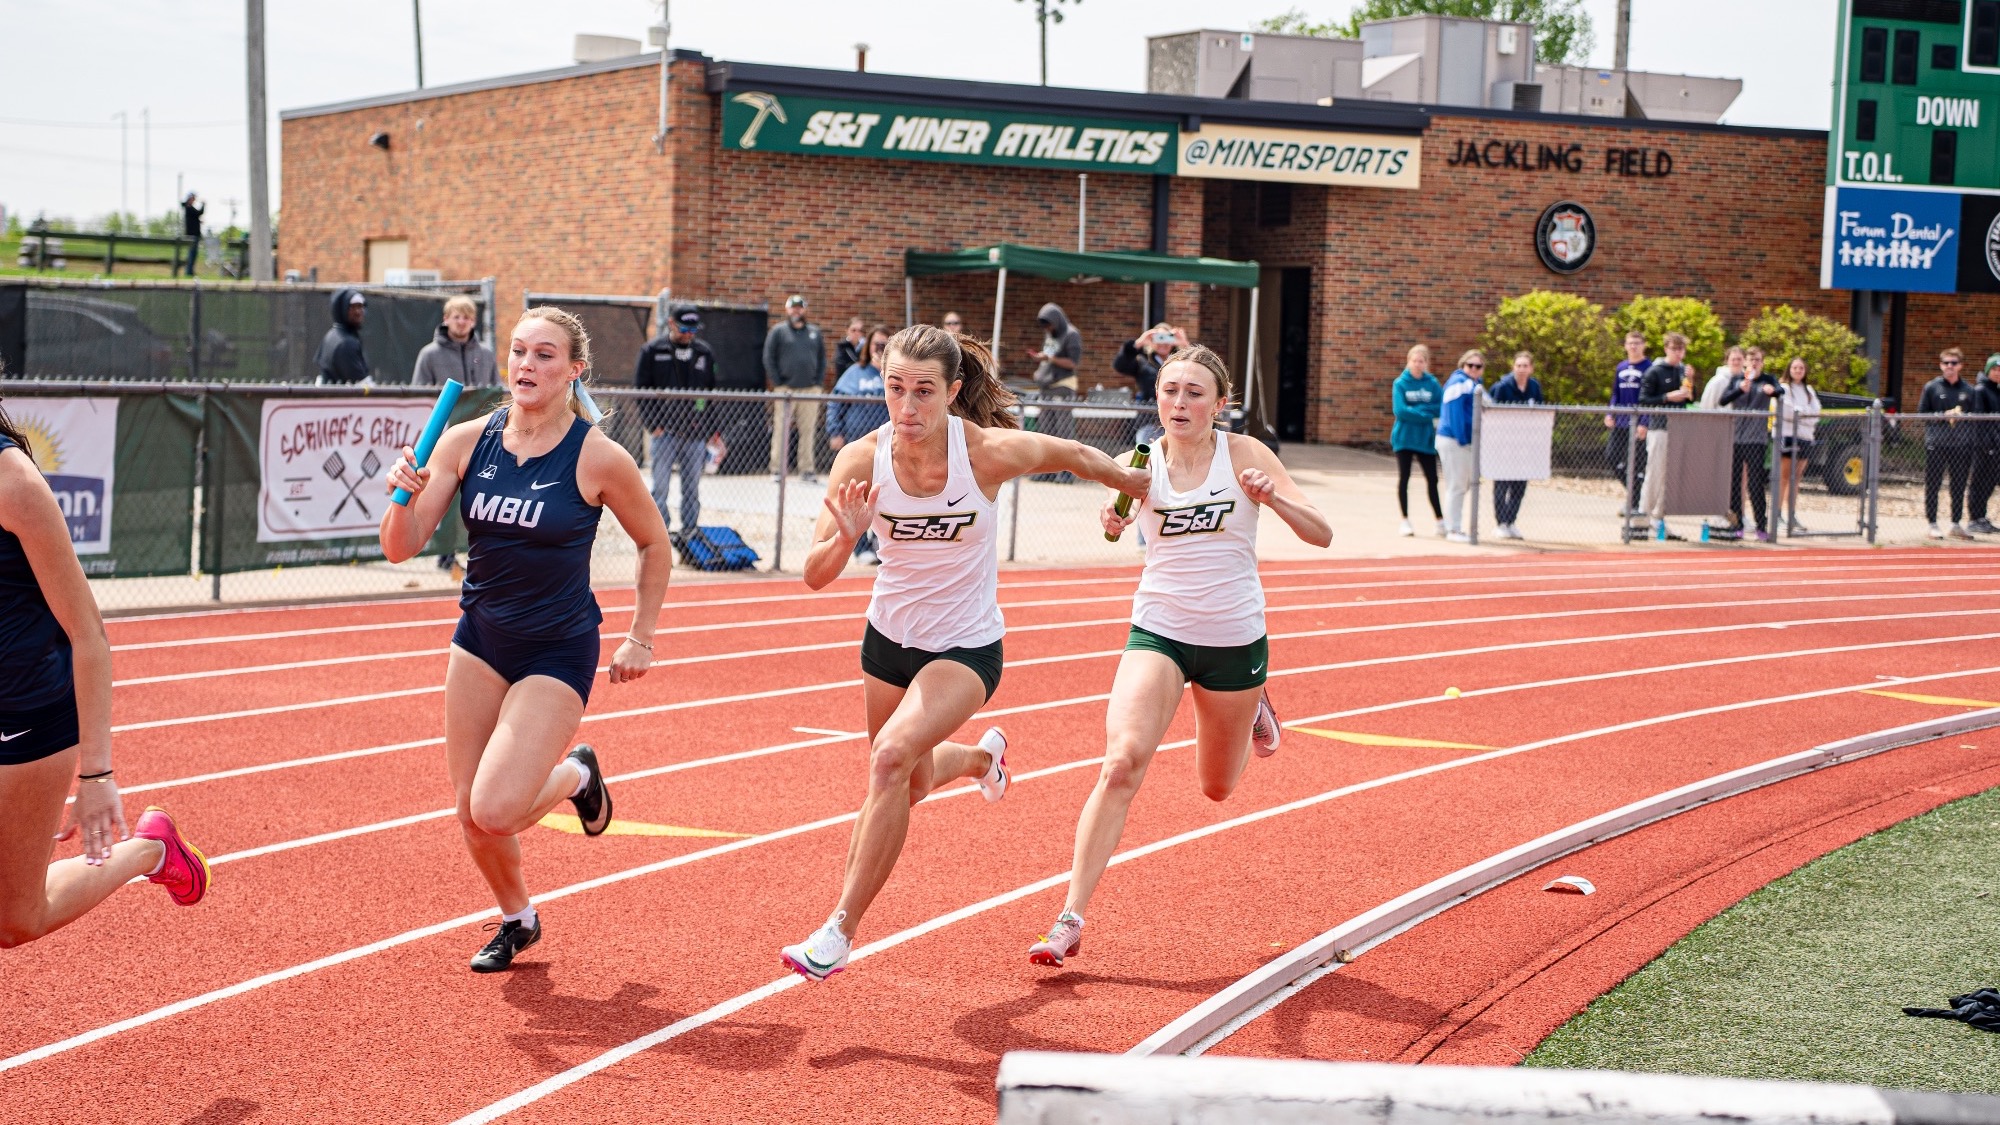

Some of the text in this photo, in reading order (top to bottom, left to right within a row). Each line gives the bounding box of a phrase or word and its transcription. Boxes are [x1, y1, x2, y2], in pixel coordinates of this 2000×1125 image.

[1916, 96, 1979, 128] DOWN
[800, 110, 1169, 165] S&T MINER ATHLETICS
[1184, 138, 1409, 176] @MINERSPORTS
[1446, 138, 1673, 178] JACKLING FIELD
[1845, 151, 1903, 183] T.O.L.
[1839, 210, 1942, 241] Forum Dental
[280, 413, 364, 463] SCRUFF'S
[469, 492, 545, 529] MBU
[891, 515, 972, 539] S&T
[1162, 503, 1231, 534] S&T
